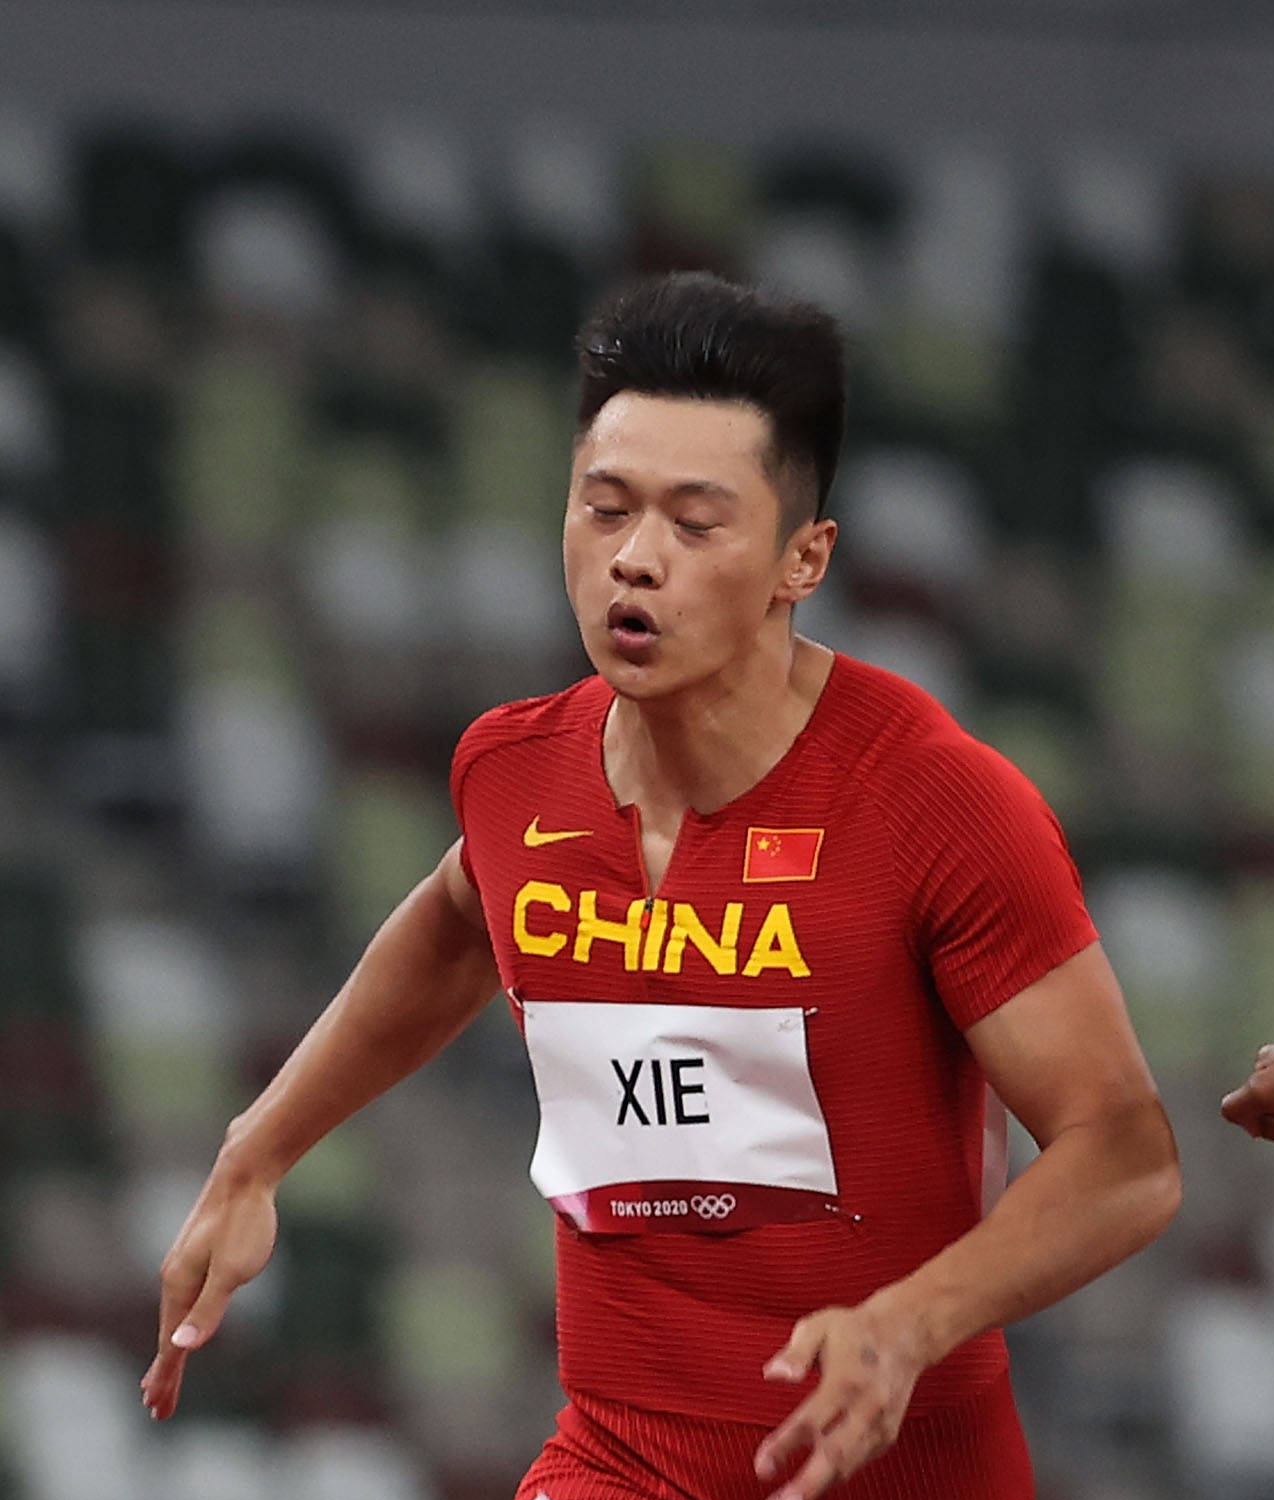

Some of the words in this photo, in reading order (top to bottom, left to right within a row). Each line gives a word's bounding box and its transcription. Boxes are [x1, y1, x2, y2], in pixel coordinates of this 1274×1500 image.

[513, 880, 812, 978] CHINA
[611, 1058, 711, 1126] XIE
[610, 1199, 652, 1217] TOKYO
[653, 1199, 689, 1216] 2020
